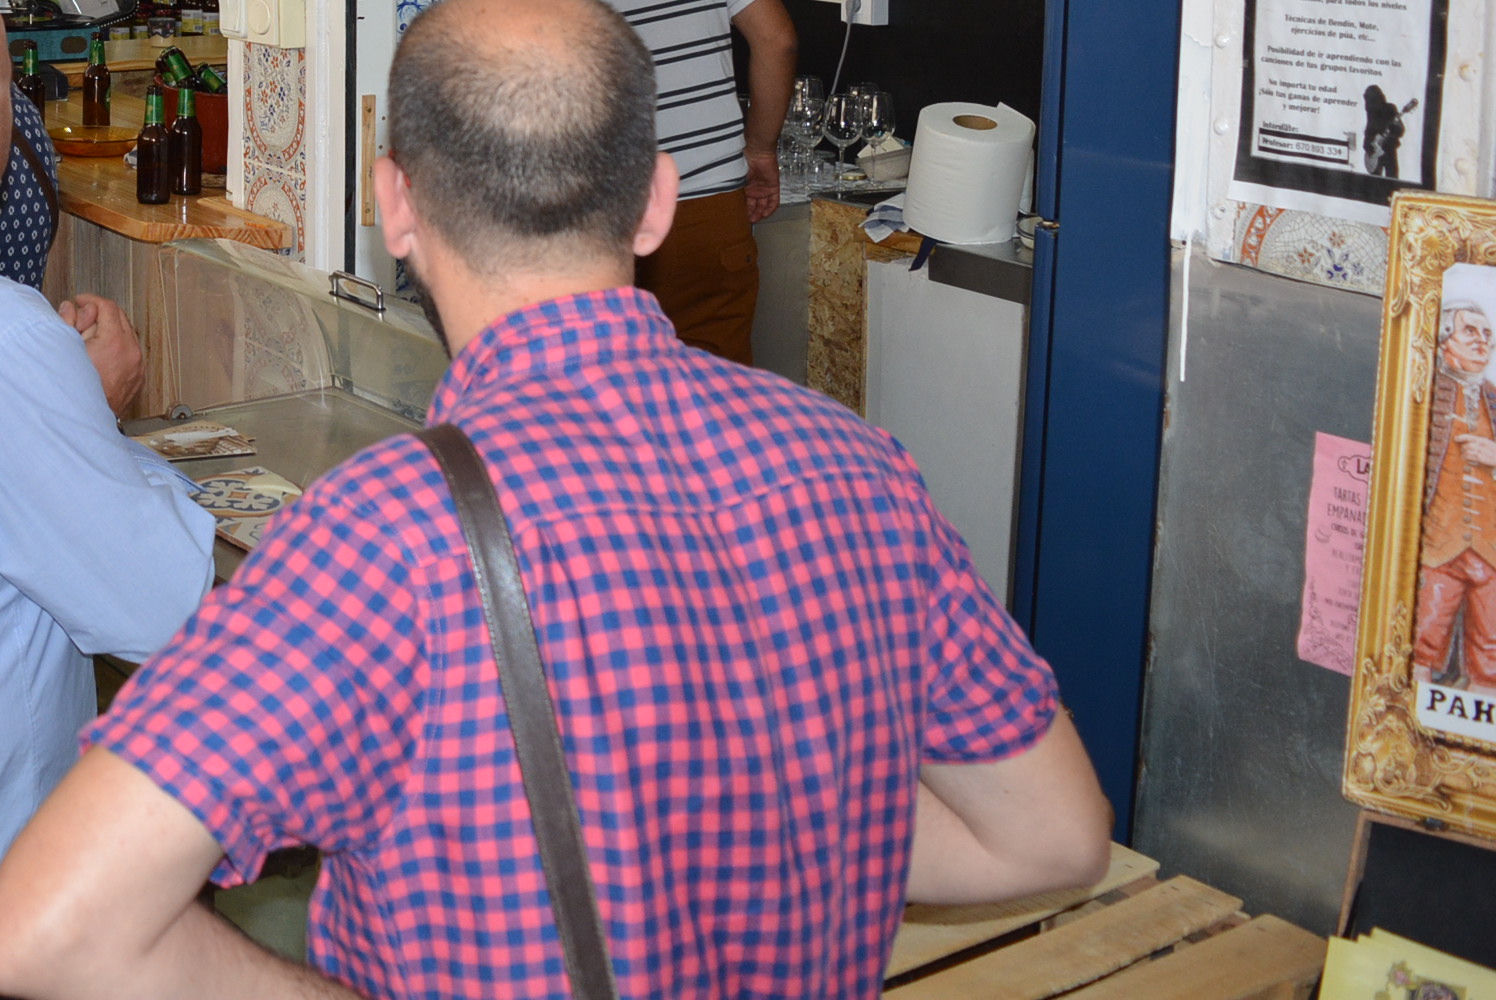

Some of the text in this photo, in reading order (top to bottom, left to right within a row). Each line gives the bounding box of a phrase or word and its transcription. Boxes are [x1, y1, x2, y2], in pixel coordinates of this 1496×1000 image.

[1345, 0, 1366, 7] todos
[1368, 0, 1379, 8] los
[1381, 1, 1407, 10] niveles
[1318, 17, 1326, 25] de
[1307, 50, 1316, 58] de
[1327, 52, 1373, 64] aprendiendo
[1296, 60, 1304, 68] de
[1320, 64, 1347, 72] grupos
[1279, 79, 1306, 90] importa
[1309, 83, 1316, 91] tu
[1318, 85, 1337, 93] edad
[1288, 92, 1310, 102] ganas
[1312, 95, 1320, 103] de
[1323, 96, 1357, 107] aprender
[1333, 486, 1361, 507] TARTAS
[1426, 688, 1496, 725] PAH
